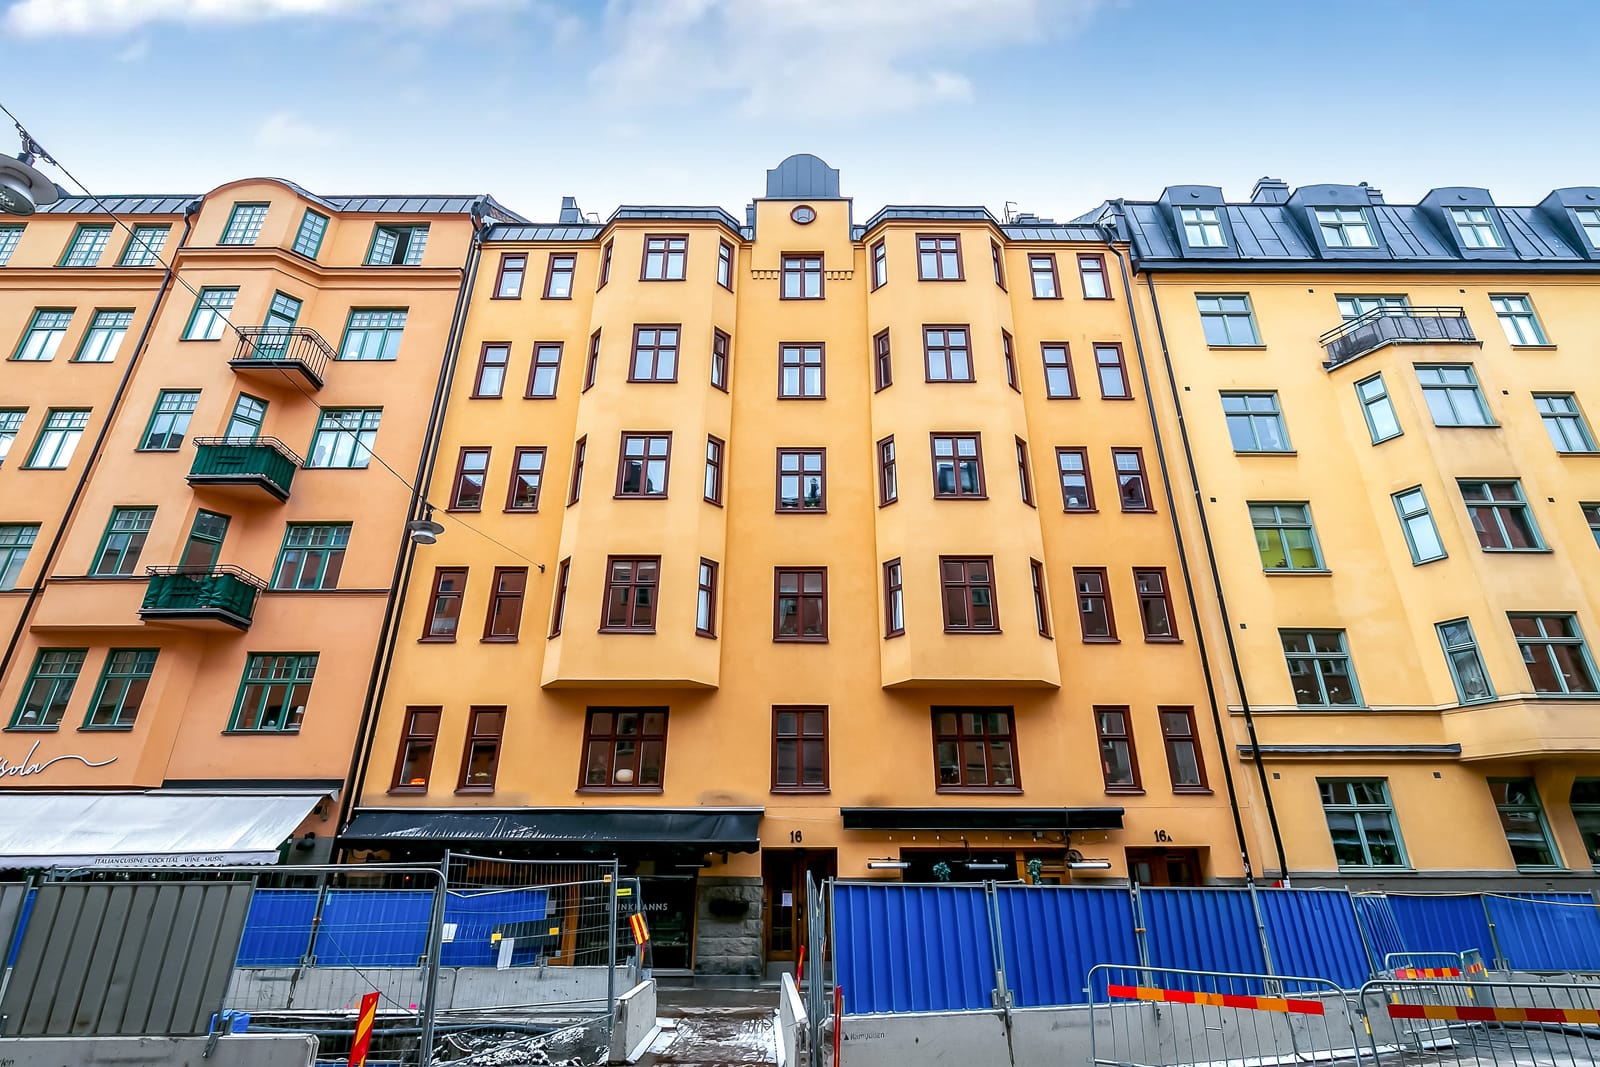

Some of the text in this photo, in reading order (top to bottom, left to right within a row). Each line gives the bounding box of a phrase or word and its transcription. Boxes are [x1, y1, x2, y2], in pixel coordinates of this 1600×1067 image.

[790, 830, 803, 843] 16
[95, 857, 120, 865] ITALIAN
[605, 903, 668, 911] BINKANNS
